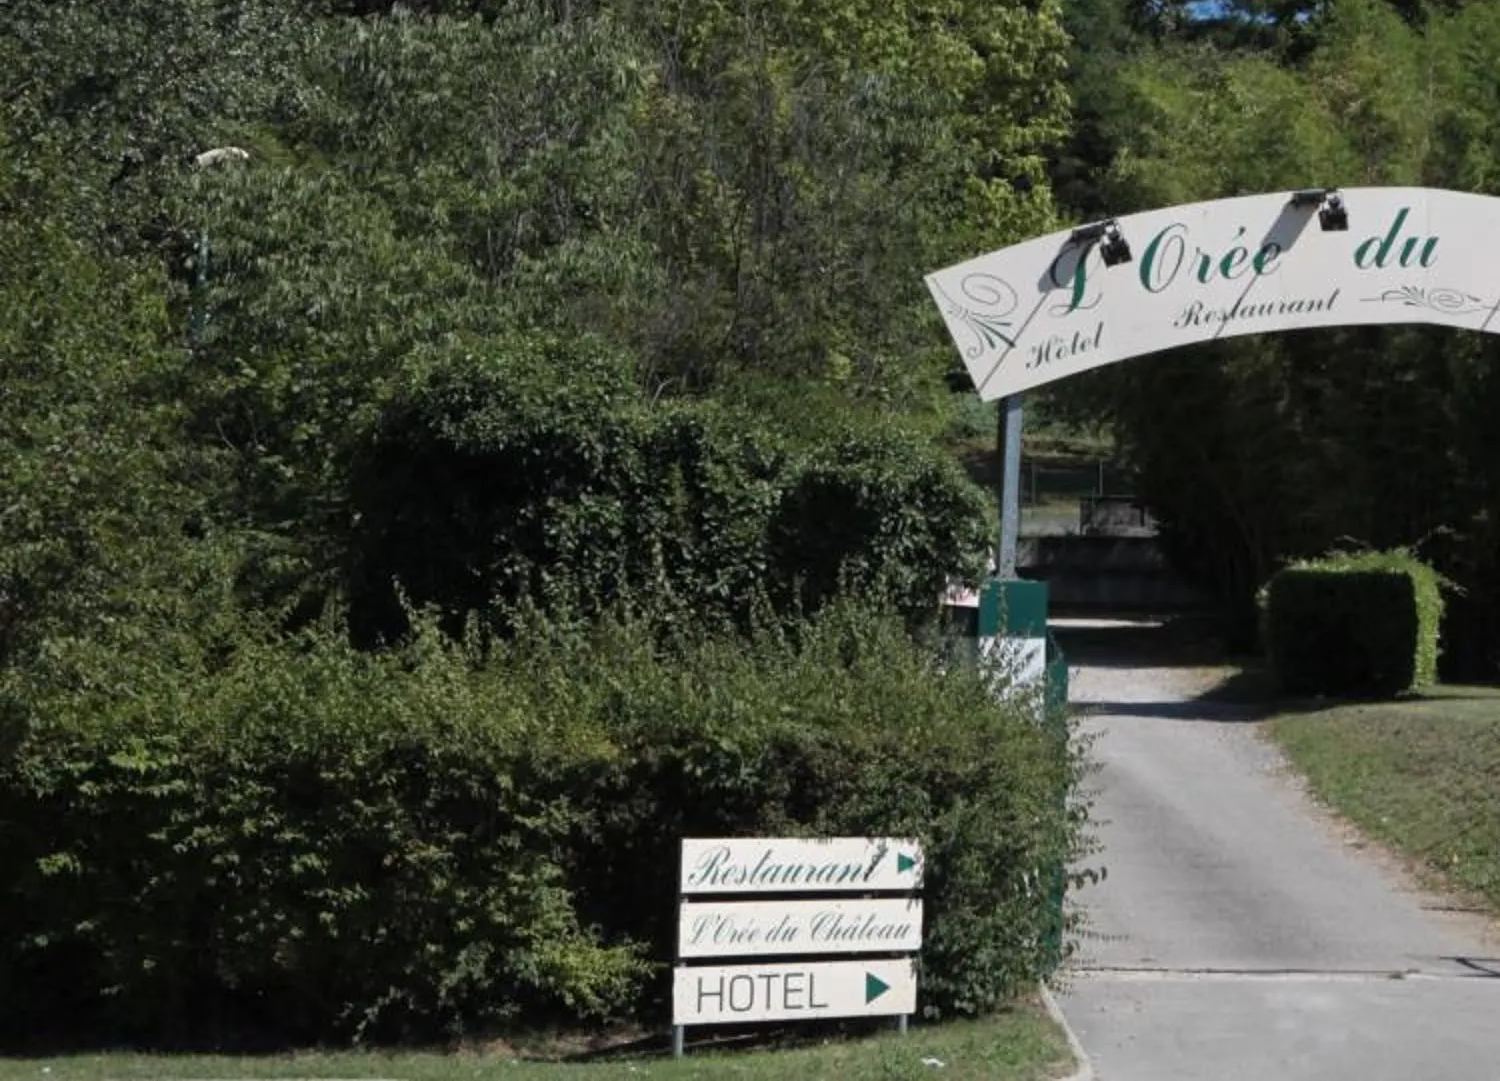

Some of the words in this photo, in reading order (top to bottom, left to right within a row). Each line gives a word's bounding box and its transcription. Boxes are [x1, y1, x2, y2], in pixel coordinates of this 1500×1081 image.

[1354, 207, 1440, 270] du
[1025, 321, 1104, 369] Hôtel
[1173, 287, 1341, 327] Restaurant
[687, 840, 889, 887] Restaurant
[690, 914, 761, 946] L'Orée
[765, 914, 799, 944] du
[810, 910, 913, 943] Château
[696, 972, 829, 1014] HOTEL
